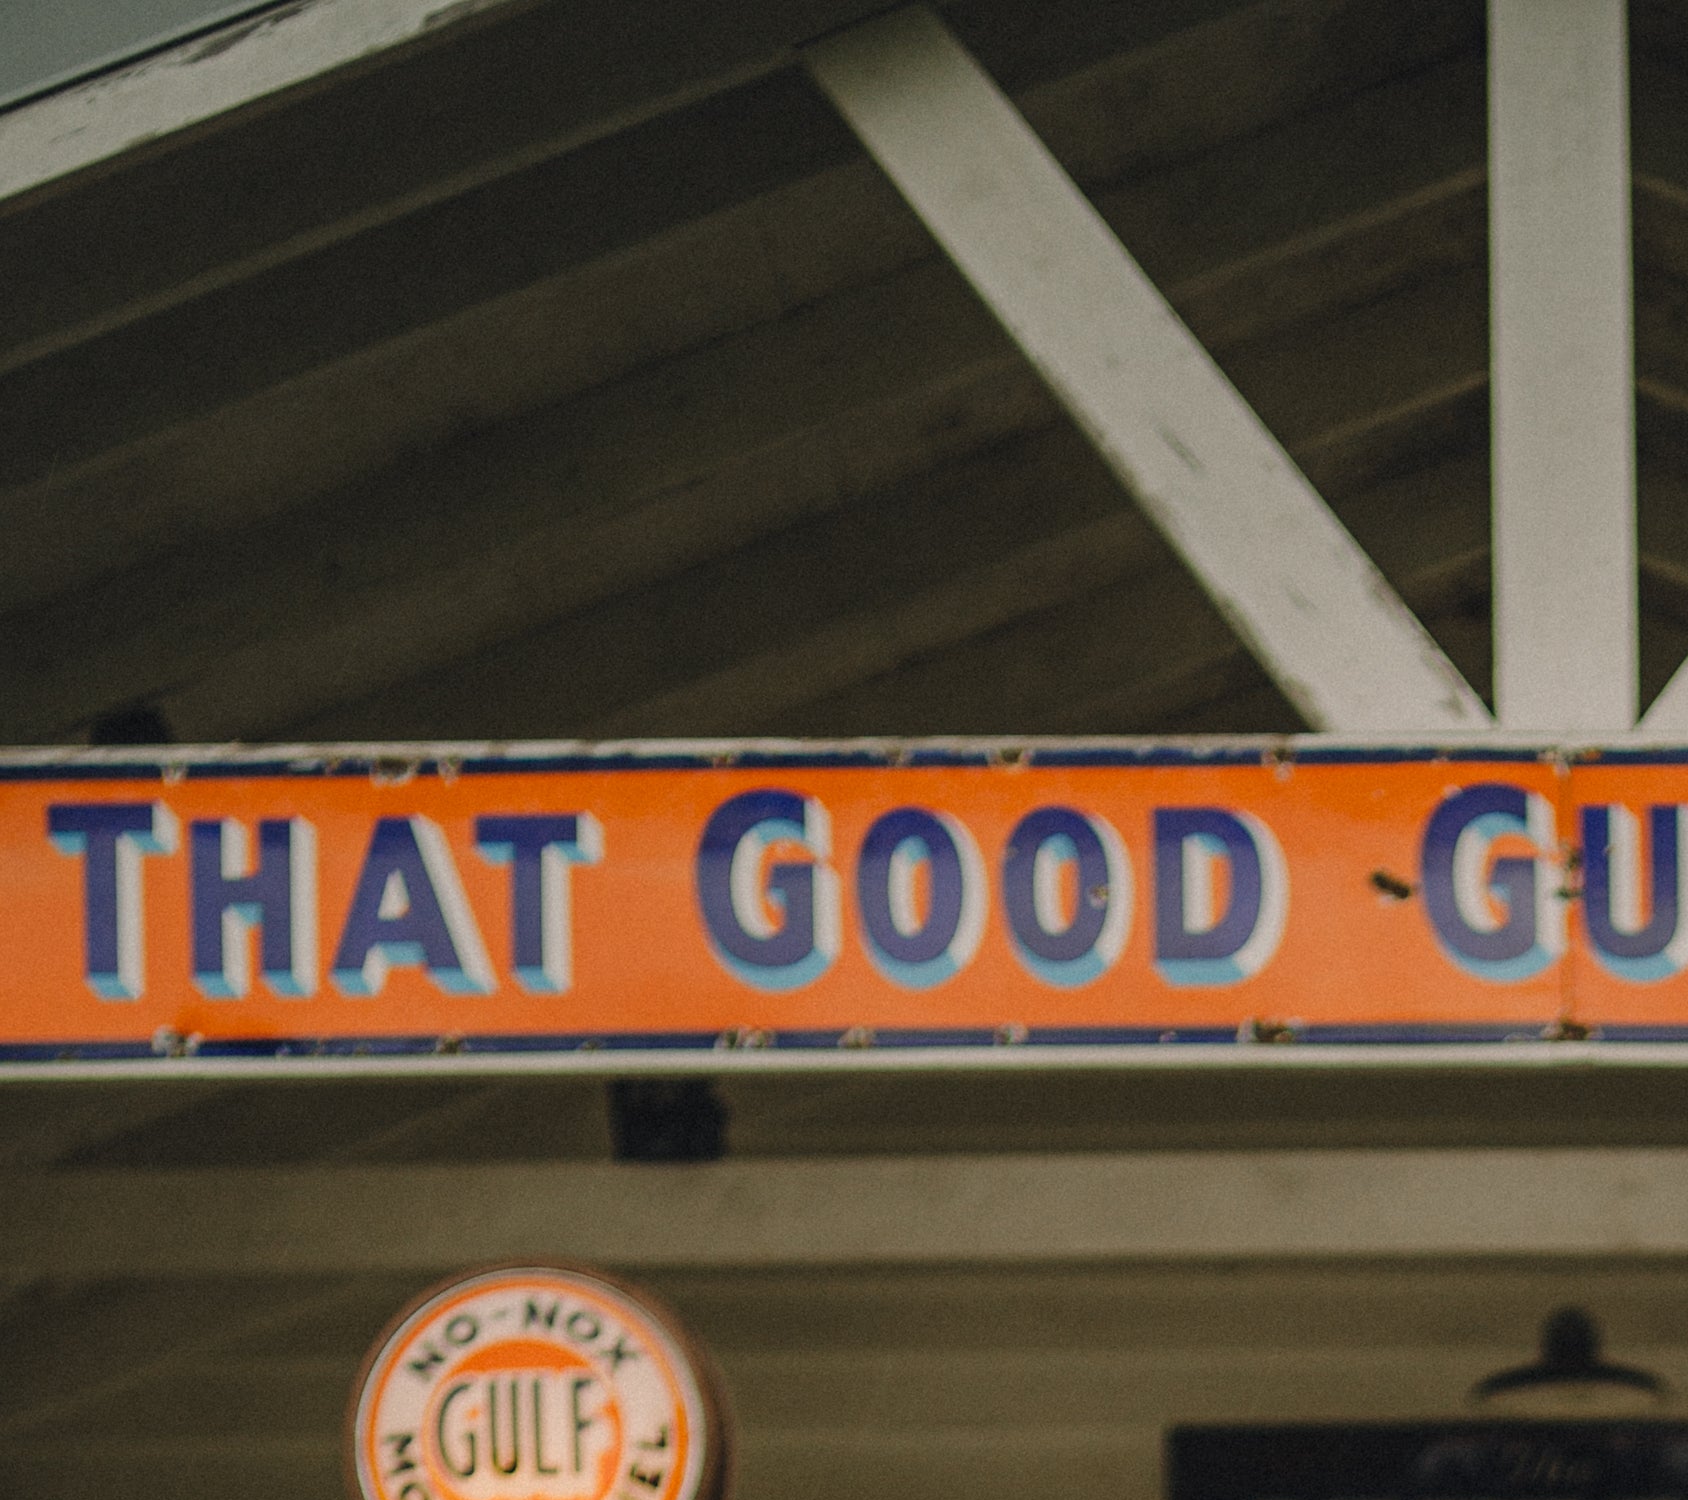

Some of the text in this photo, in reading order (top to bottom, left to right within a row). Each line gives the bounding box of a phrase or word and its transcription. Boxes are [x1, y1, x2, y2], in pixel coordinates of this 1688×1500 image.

[46, 800, 604, 996] THAT
[696, 788, 1288, 991] GOOD
[437, 1377, 594, 1477] GULF
